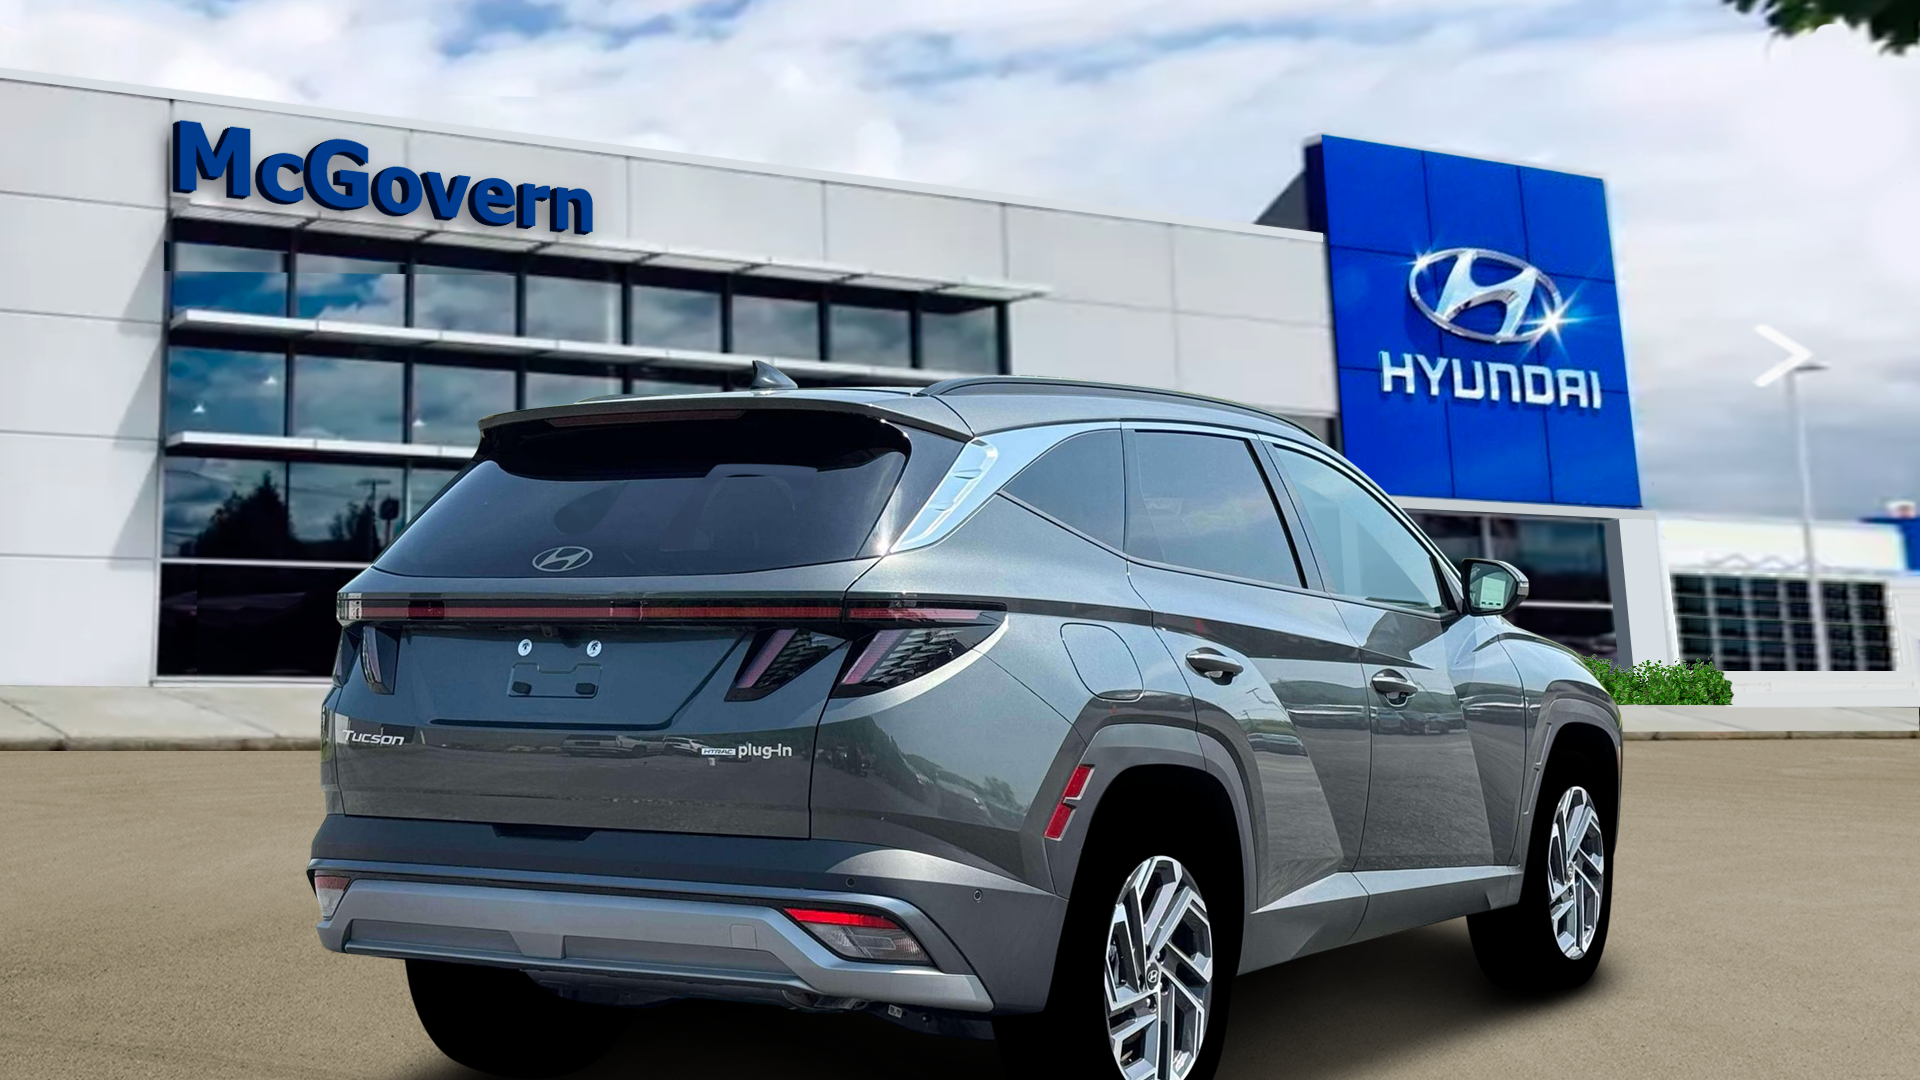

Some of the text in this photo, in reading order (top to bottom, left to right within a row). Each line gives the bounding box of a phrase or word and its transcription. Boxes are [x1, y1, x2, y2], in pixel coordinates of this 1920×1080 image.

[172, 120, 594, 235] McGovern
[1379, 350, 1602, 409] HYUNDAI
[738, 743, 792, 759] plug-in
